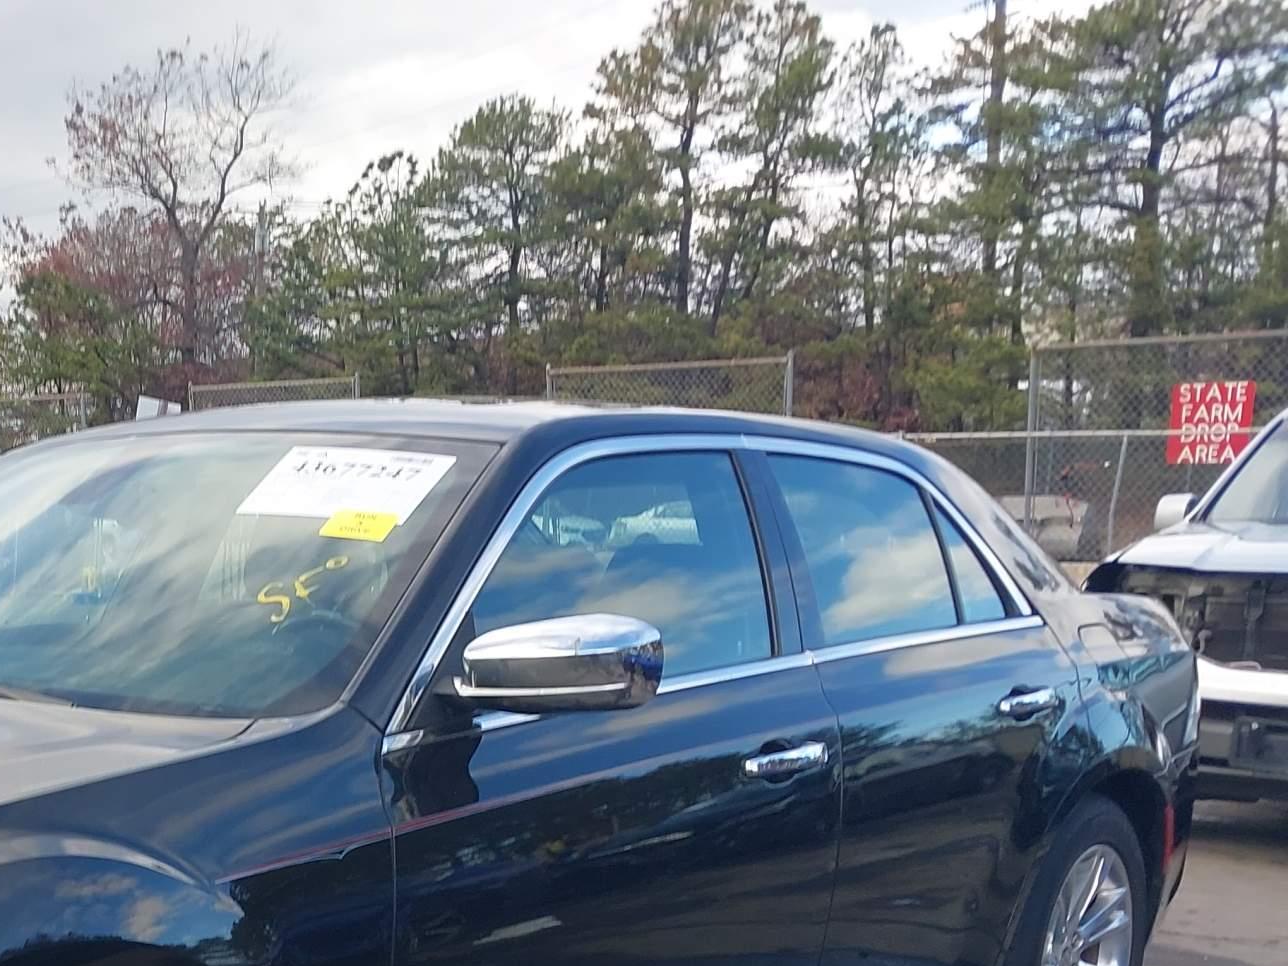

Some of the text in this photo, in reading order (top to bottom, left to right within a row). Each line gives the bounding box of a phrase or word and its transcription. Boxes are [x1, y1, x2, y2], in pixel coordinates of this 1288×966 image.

[1179, 381, 1248, 403] STATE
[1182, 403, 1244, 423] FARM
[1181, 422, 1240, 444] DROP
[1177, 443, 1237, 464] AREA
